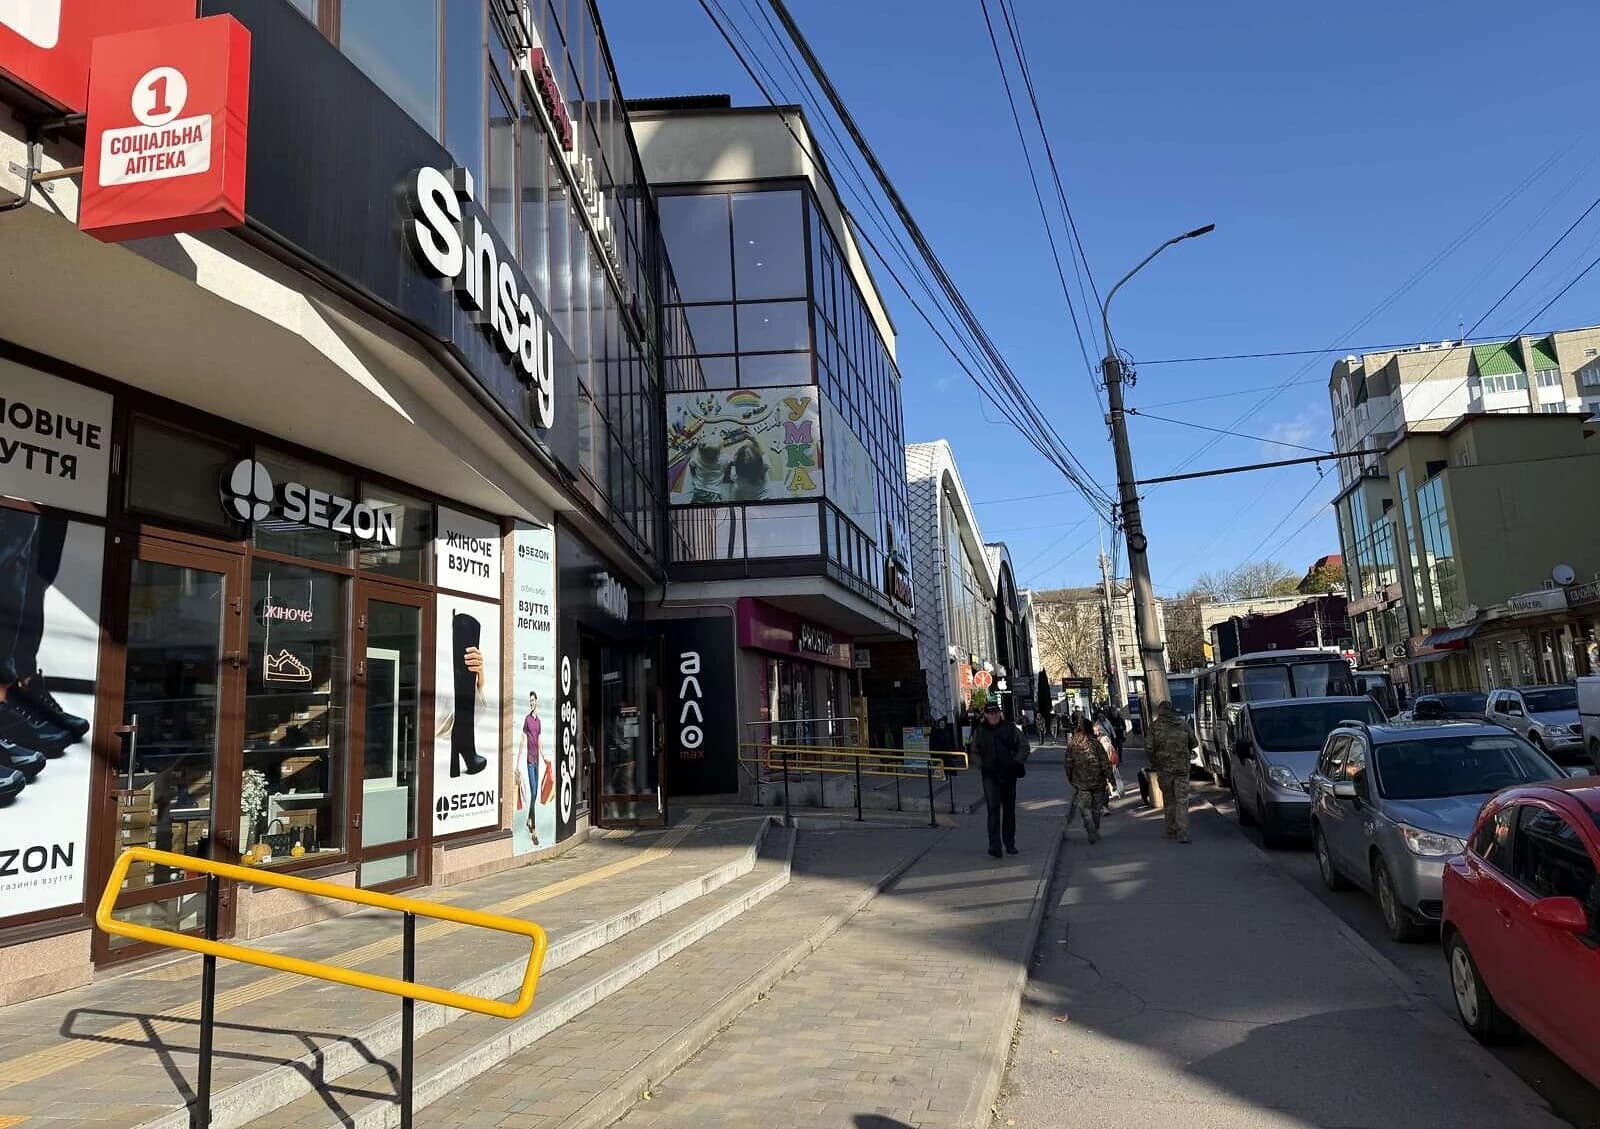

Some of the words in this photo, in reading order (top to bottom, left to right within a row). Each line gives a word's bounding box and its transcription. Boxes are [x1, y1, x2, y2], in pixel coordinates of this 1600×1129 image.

[147, 76, 172, 116] 1
[110, 125, 203, 155] СОЦІАЛЬНА
[125, 150, 186, 175] АПТЕКА
[0, 397, 101, 450] ОВІЧЕ
[783, 396, 817, 491] УМКА
[283, 482, 397, 546] SEZON
[446, 530, 493, 557] ЖІНОЧЕ
[525, 546, 549, 560] SEZON
[448, 554, 490, 578] ВЗУТТЯ
[517, 617, 550, 632] легким
[450, 790, 494, 811] SEZON
[0, 842, 74, 876] ZON
